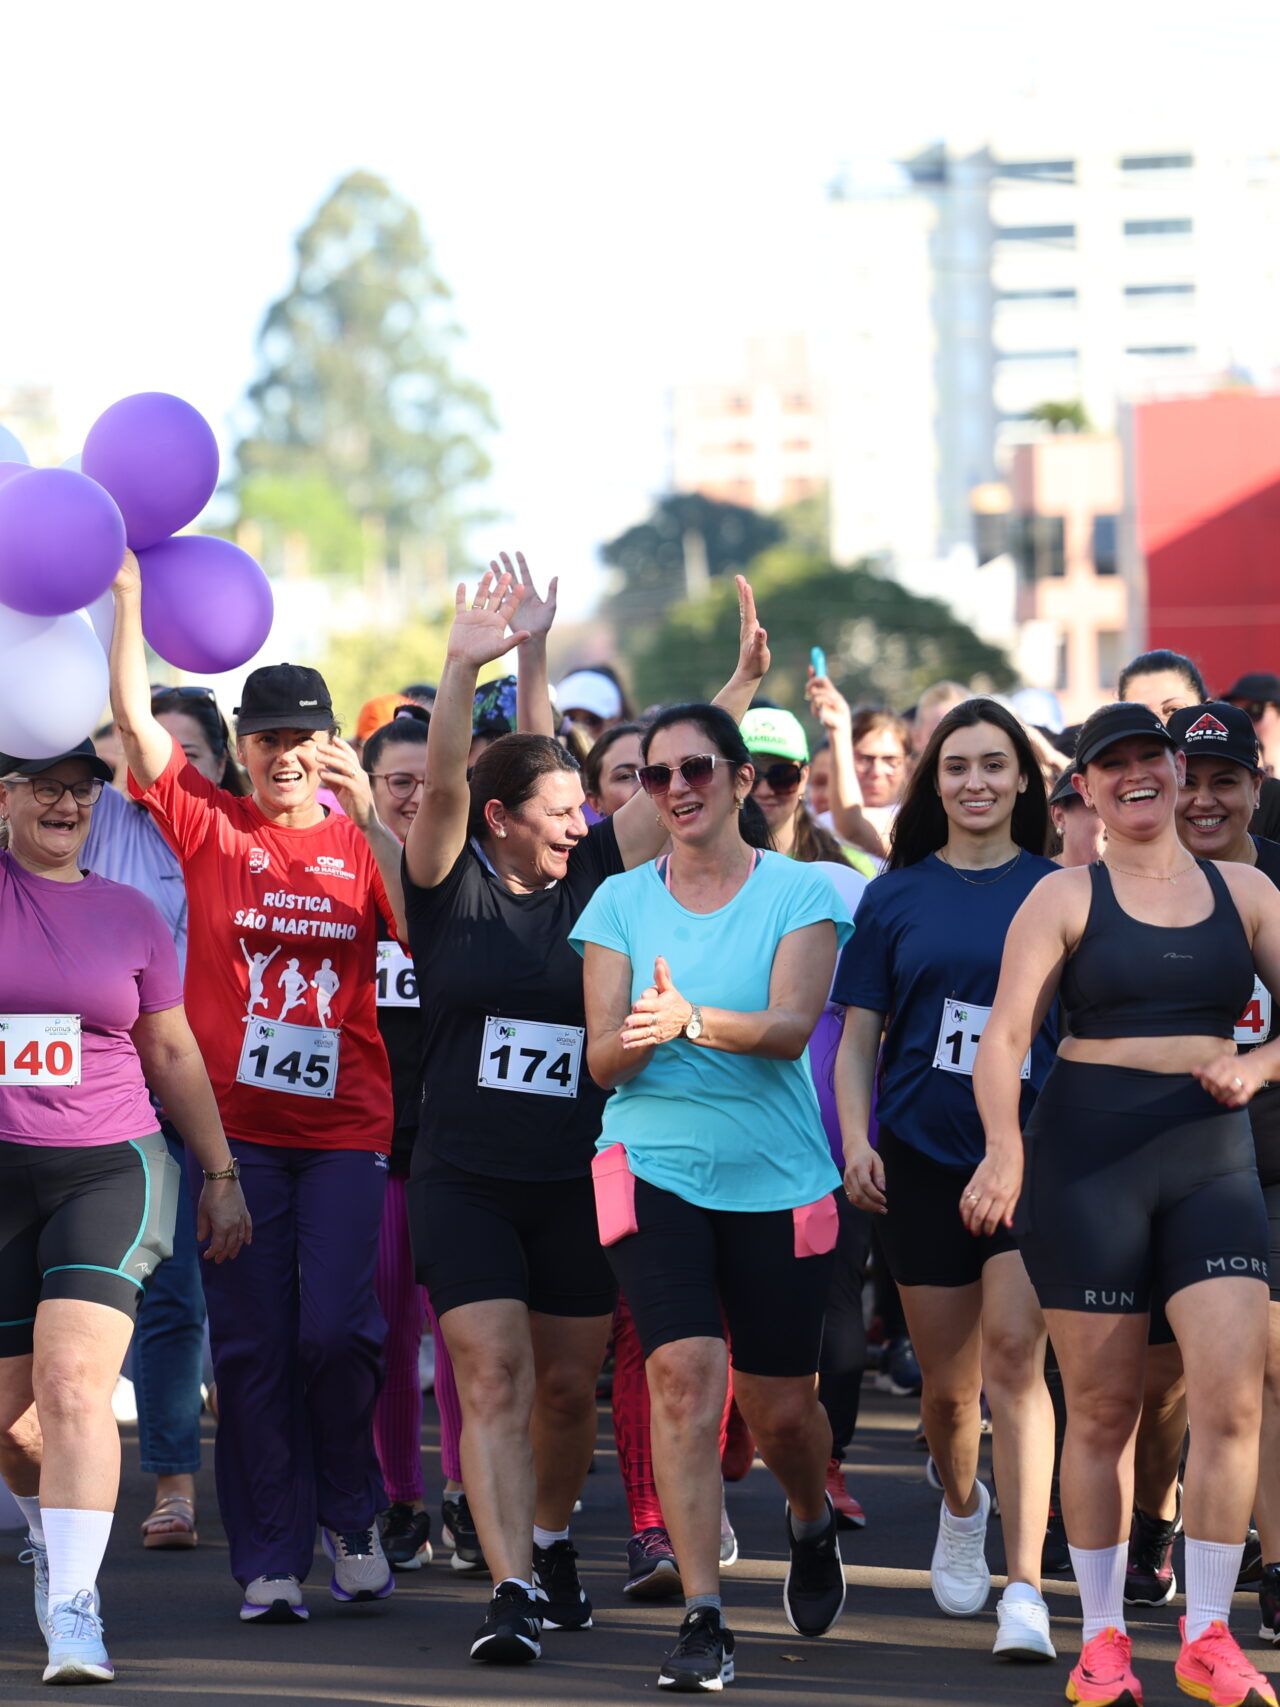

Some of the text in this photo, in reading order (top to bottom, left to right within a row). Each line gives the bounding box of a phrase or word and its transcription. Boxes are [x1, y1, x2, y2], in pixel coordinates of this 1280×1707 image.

[1184, 729, 1229, 738] MIX
[262, 889, 332, 913] RÚSTICA
[234, 908, 357, 940] SÃO MARTINHO
[376, 968, 419, 1000] 16
[1235, 999, 1265, 1033] 4
[249, 1044, 330, 1088] 145
[490, 1044, 572, 1087] 174
[1206, 1256, 1268, 1277] MORE
[1084, 1290, 1135, 1307] RUN
